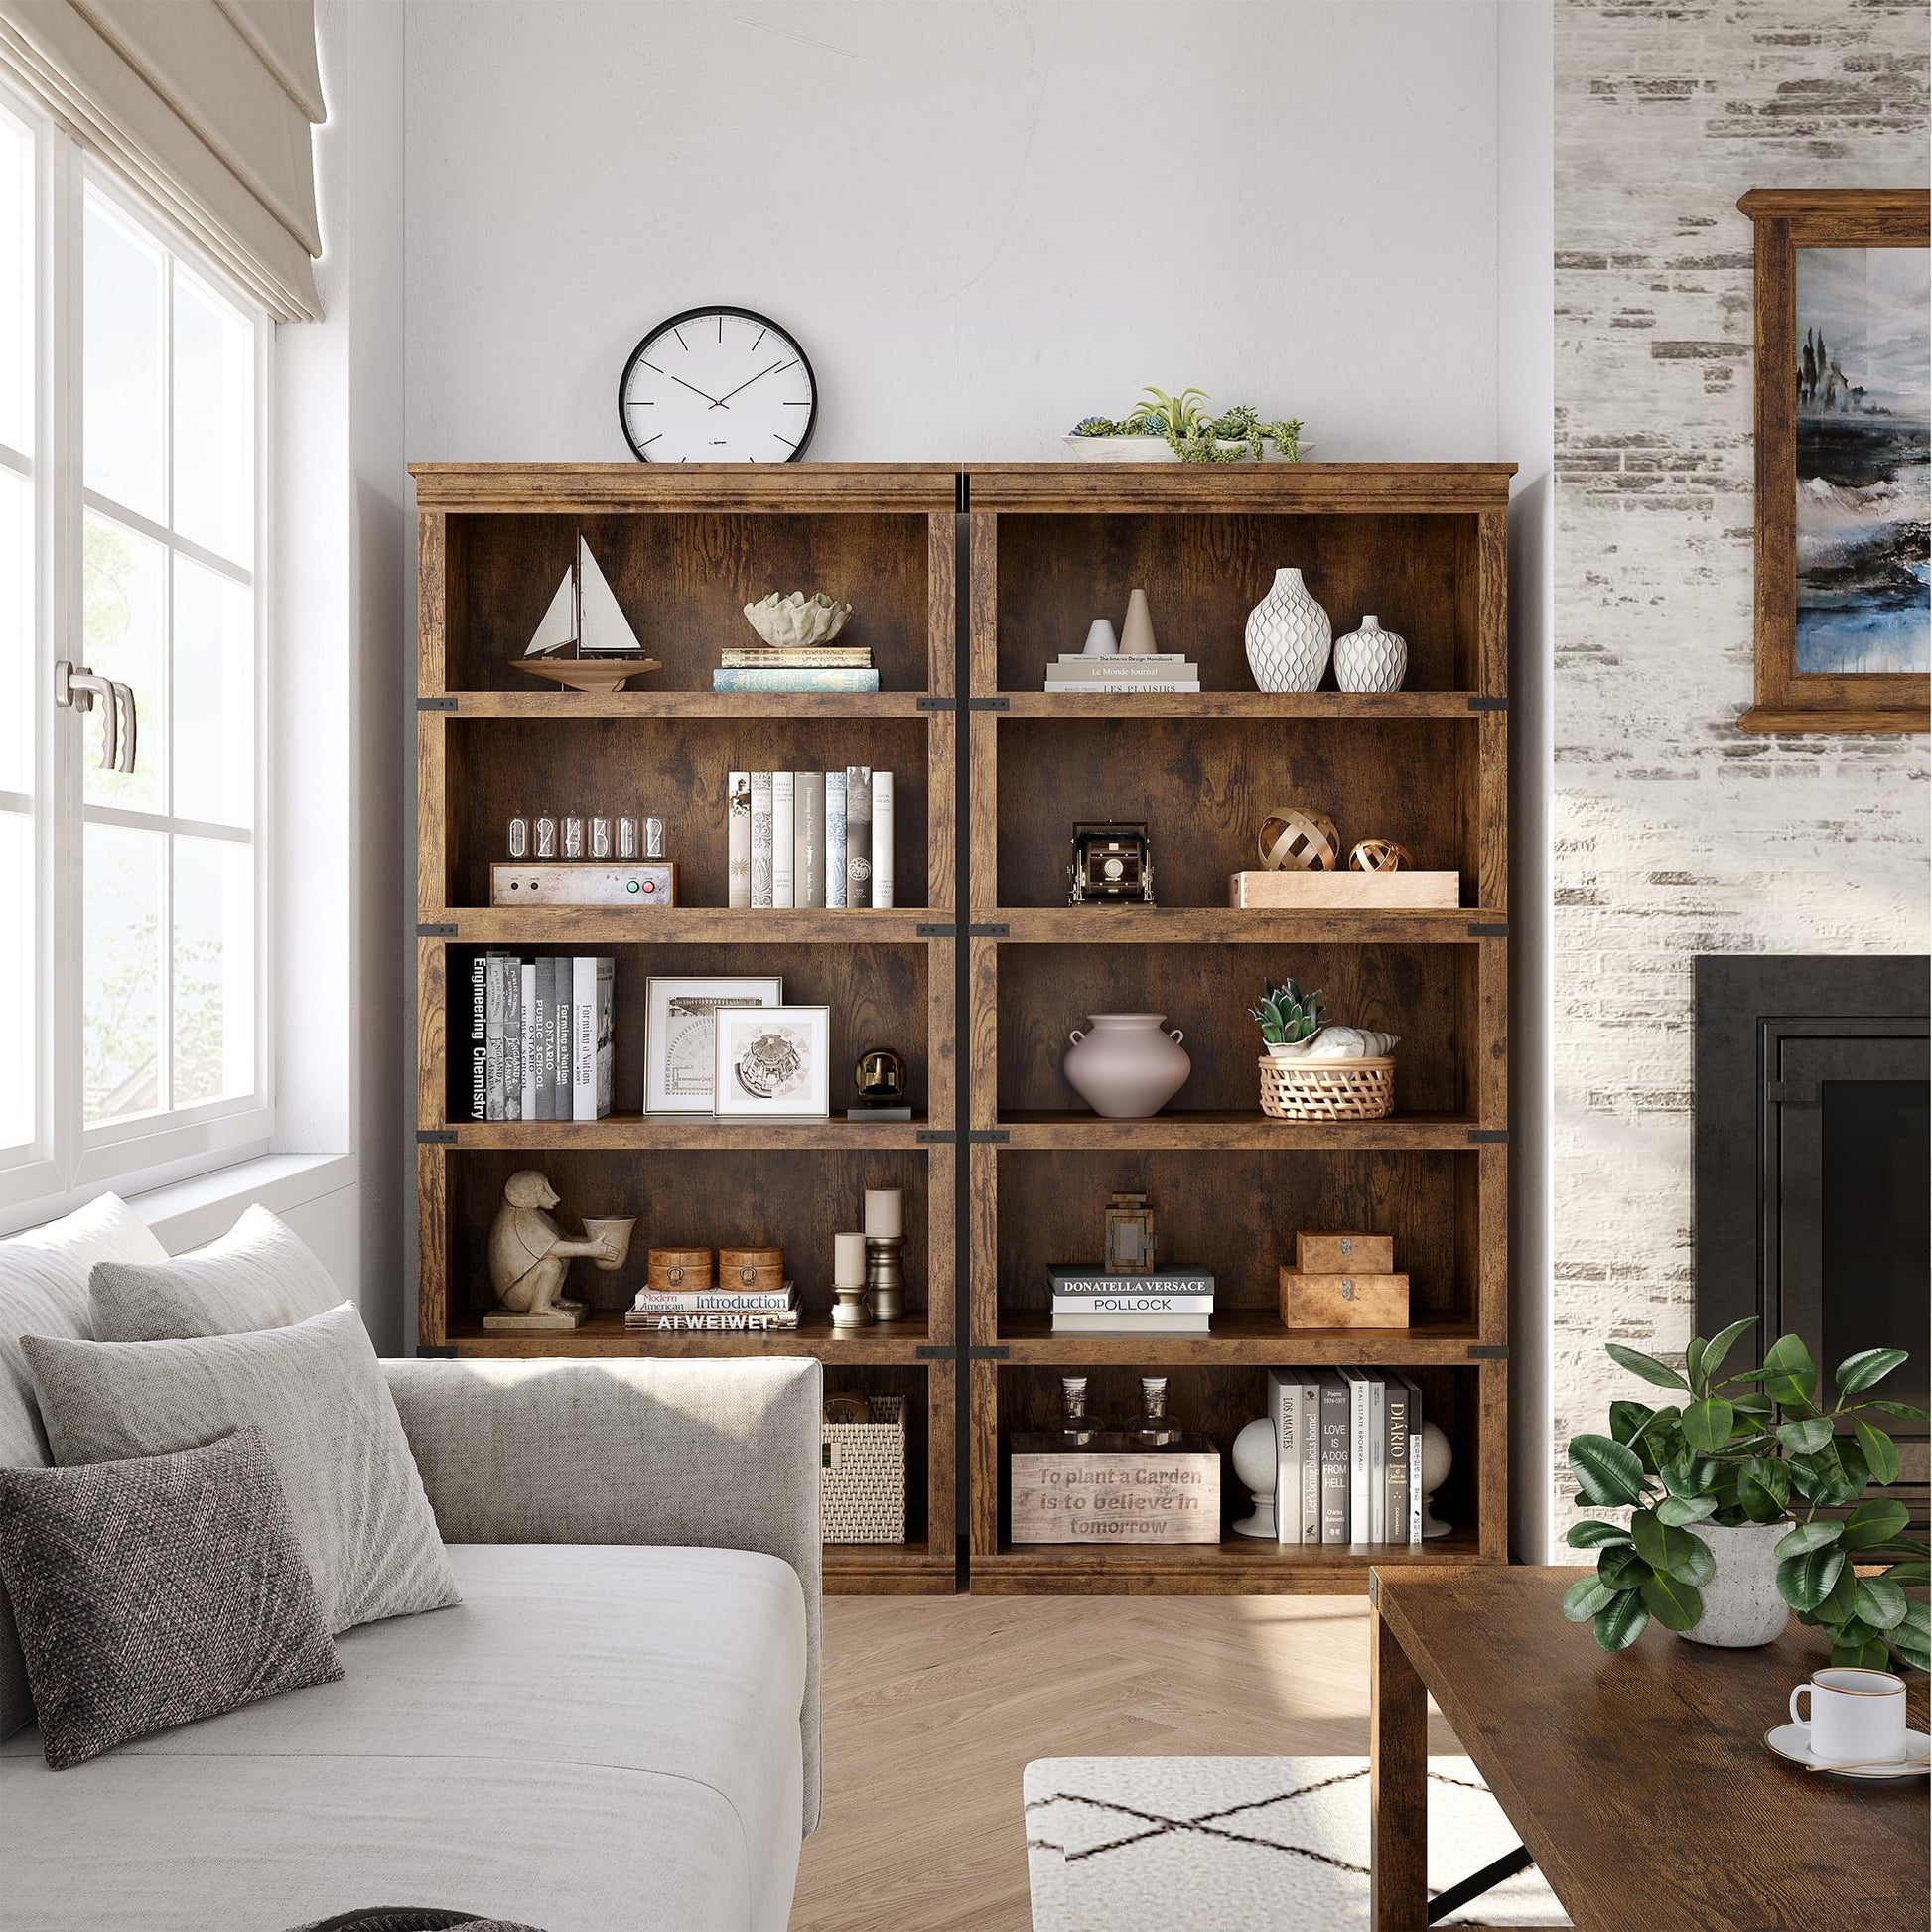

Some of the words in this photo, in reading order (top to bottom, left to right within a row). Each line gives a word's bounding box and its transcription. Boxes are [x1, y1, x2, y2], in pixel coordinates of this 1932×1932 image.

[472, 957, 486, 1039] Engineering
[560, 1004, 570, 1044] Forming
[581, 1004, 593, 1044] Forming
[545, 1020, 554, 1071] ONTARIO
[503, 1035, 520, 1078] ENGLAND
[561, 1053, 570, 1085] Nation
[582, 1053, 593, 1085] Nation
[471, 1046, 486, 1120] Chemistry
[1064, 1281, 1143, 1292] DONATELLA
[1145, 1281, 1206, 1292] VERSACE
[640, 1302, 684, 1311] American
[643, 1294, 677, 1303] Modern
[695, 1295, 787, 1310] Introduction
[1094, 1299, 1172, 1311] POLLOCK
[658, 1315, 679, 1330] AI
[686, 1315, 769, 1330] WEIWEI
[1283, 1397, 1293, 1412] LOS
[1283, 1413, 1293, 1449] AMANTES
[1306, 1413, 1317, 1441] home!
[1323, 1425, 1346, 1435] LOVE
[1390, 1403, 1408, 1458] DIÁRIO
[1331, 1439, 1339, 1448] IS
[1306, 1442, 1316, 1468] blacks
[1321, 1451, 1329, 1461] A
[1329, 1451, 1348, 1461] DOG
[1039, 1468, 1061, 1484] To
[1065, 1467, 1115, 1488] plant
[1119, 1472, 1130, 1484] a
[1135, 1468, 1202, 1484] Garden
[1306, 1468, 1319, 1492] bring
[1322, 1465, 1347, 1475] FROM
[1324, 1478, 1345, 1488] HELL
[1040, 1493, 1058, 1510] is
[1064, 1494, 1087, 1510] to
[1093, 1493, 1173, 1510] believe
[1178, 1493, 1199, 1510] in
[1306, 1492, 1316, 1514] Let's
[1070, 1518, 1168, 1534] tomorrow
